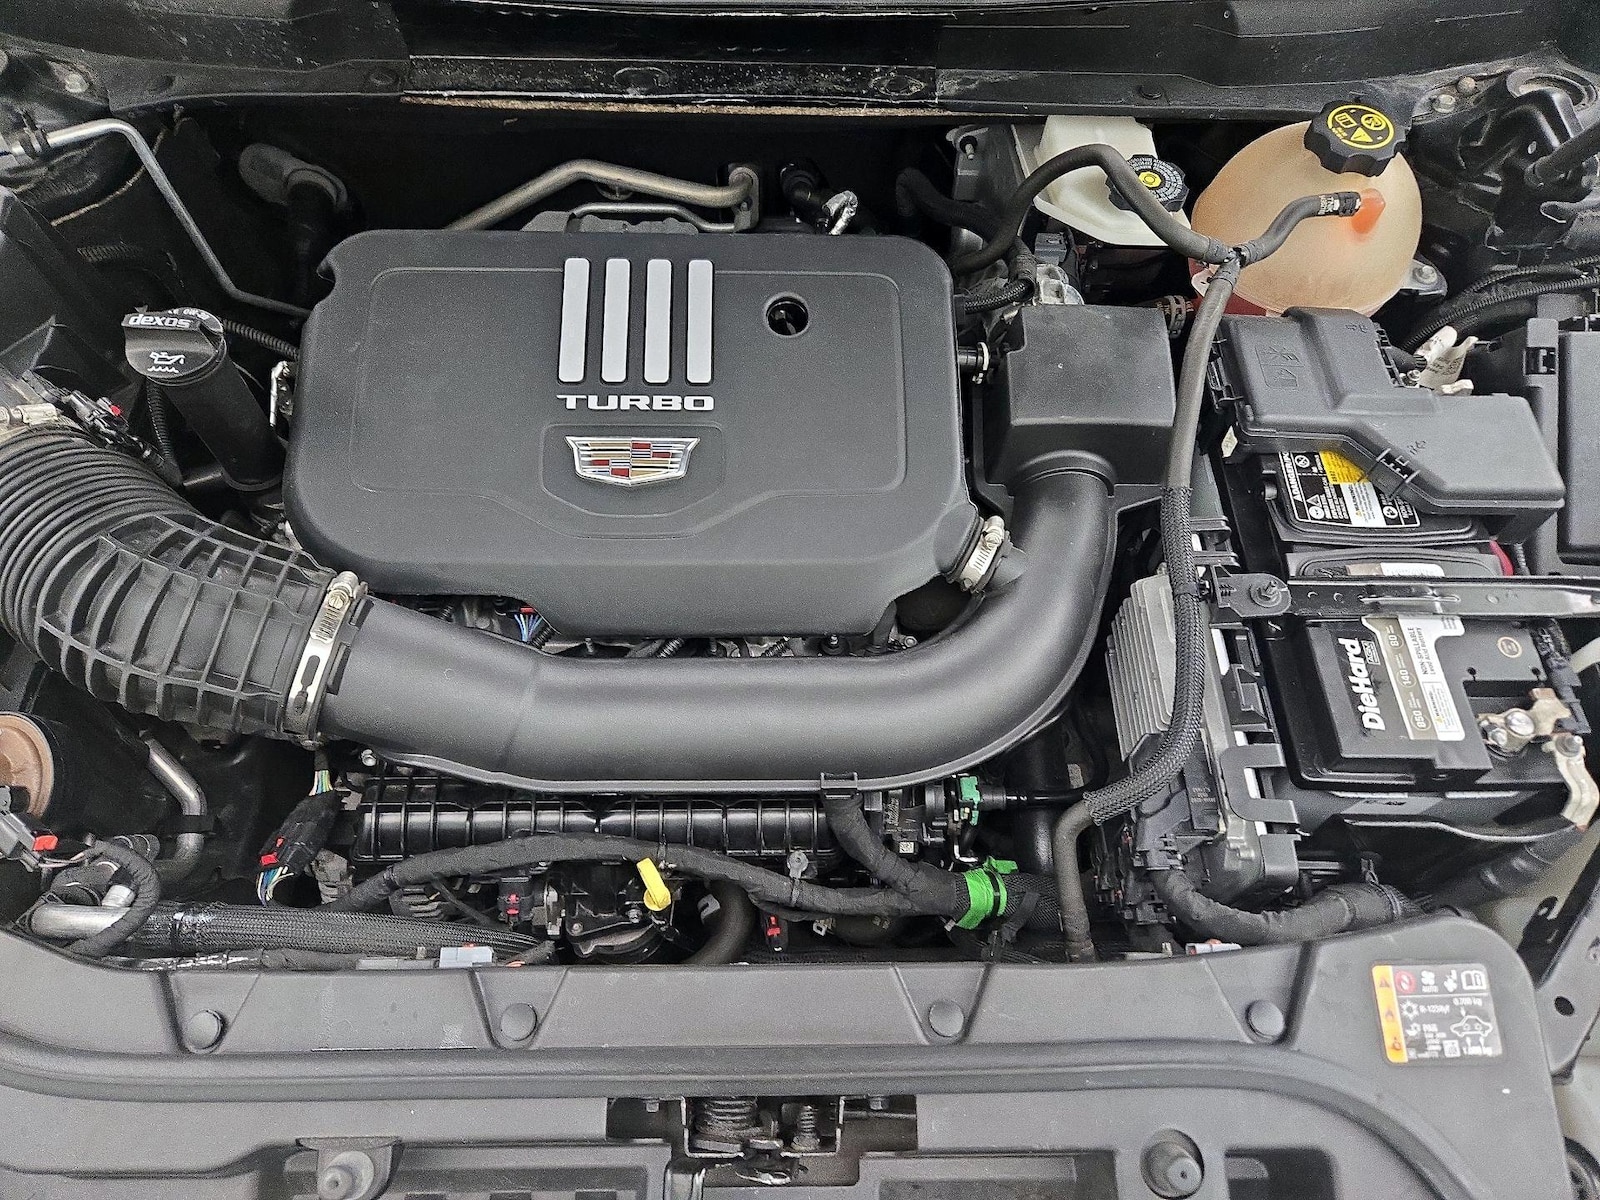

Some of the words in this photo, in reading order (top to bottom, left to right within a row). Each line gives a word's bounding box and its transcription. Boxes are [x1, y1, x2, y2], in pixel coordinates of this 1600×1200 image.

[128, 313, 193, 329] dexos
[556, 394, 714, 411] TURBO
[1388, 634, 1399, 647] 80
[1426, 661, 1436, 674] Lead
[1338, 637, 1386, 730] DieHard
[1400, 669, 1412, 685] 140
[1413, 710, 1427, 728] 850
